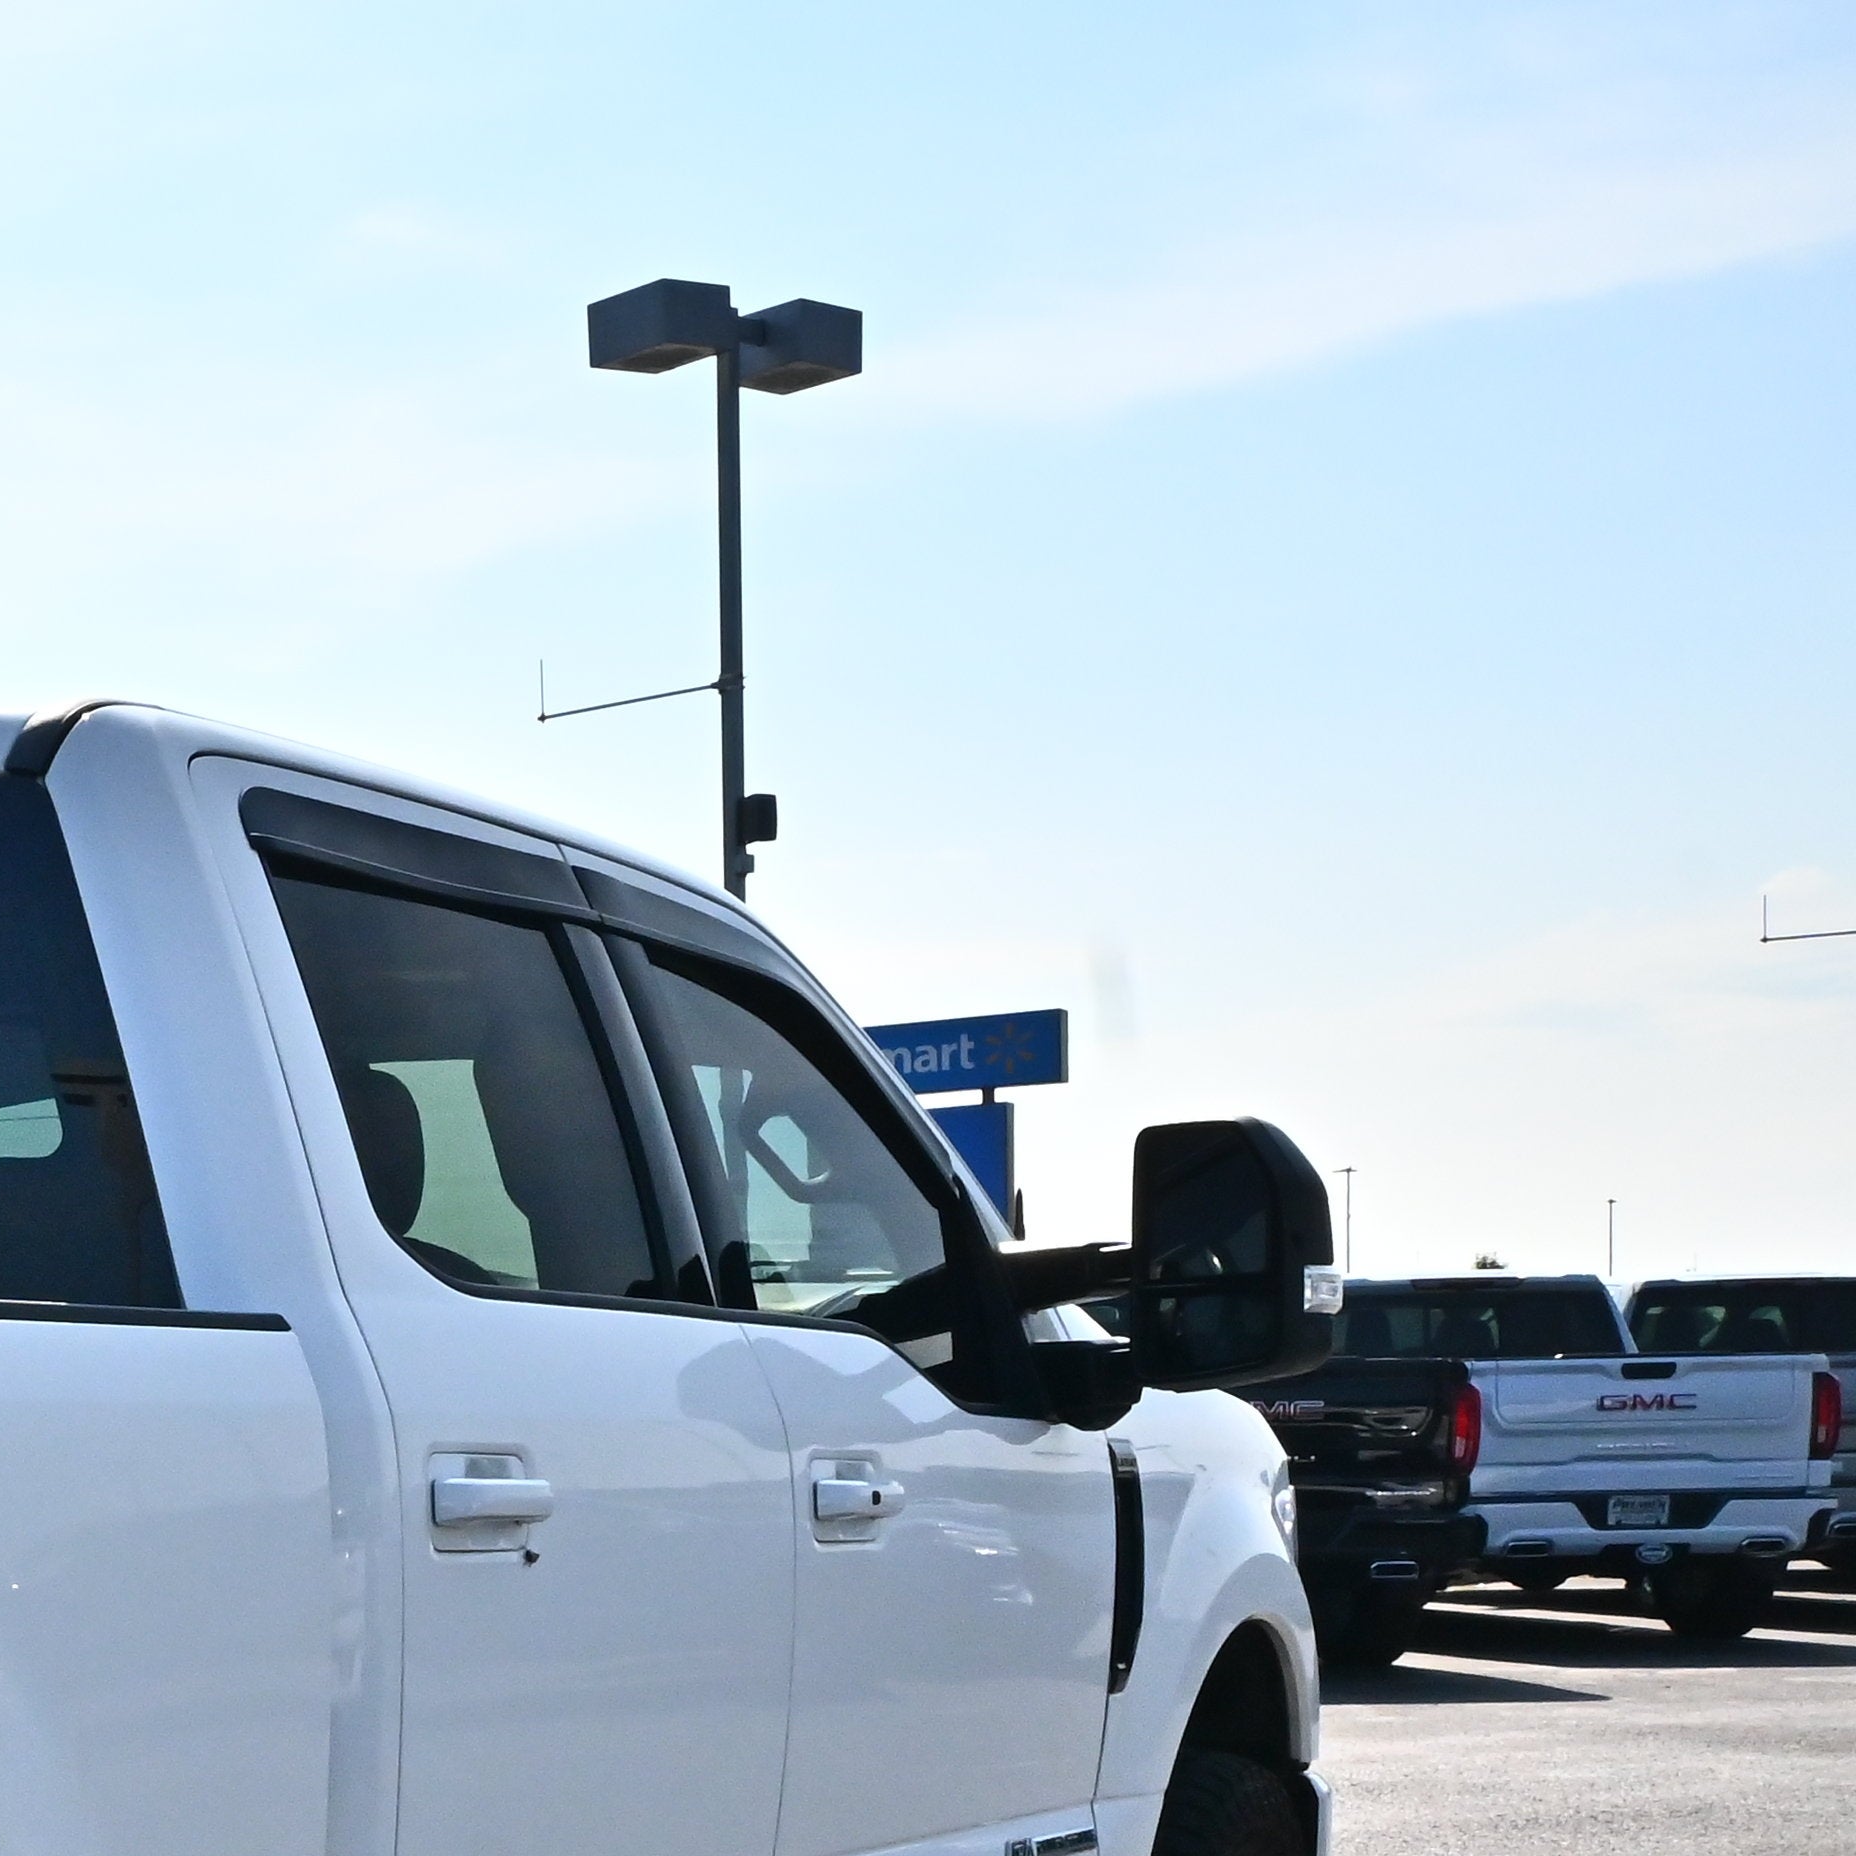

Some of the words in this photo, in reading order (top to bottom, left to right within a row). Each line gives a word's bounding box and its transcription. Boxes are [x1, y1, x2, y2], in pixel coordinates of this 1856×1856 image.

[884, 1032, 976, 1074] mart
[1249, 1400, 1325, 1421] MC
[1596, 1393, 1698, 1412] GMC
